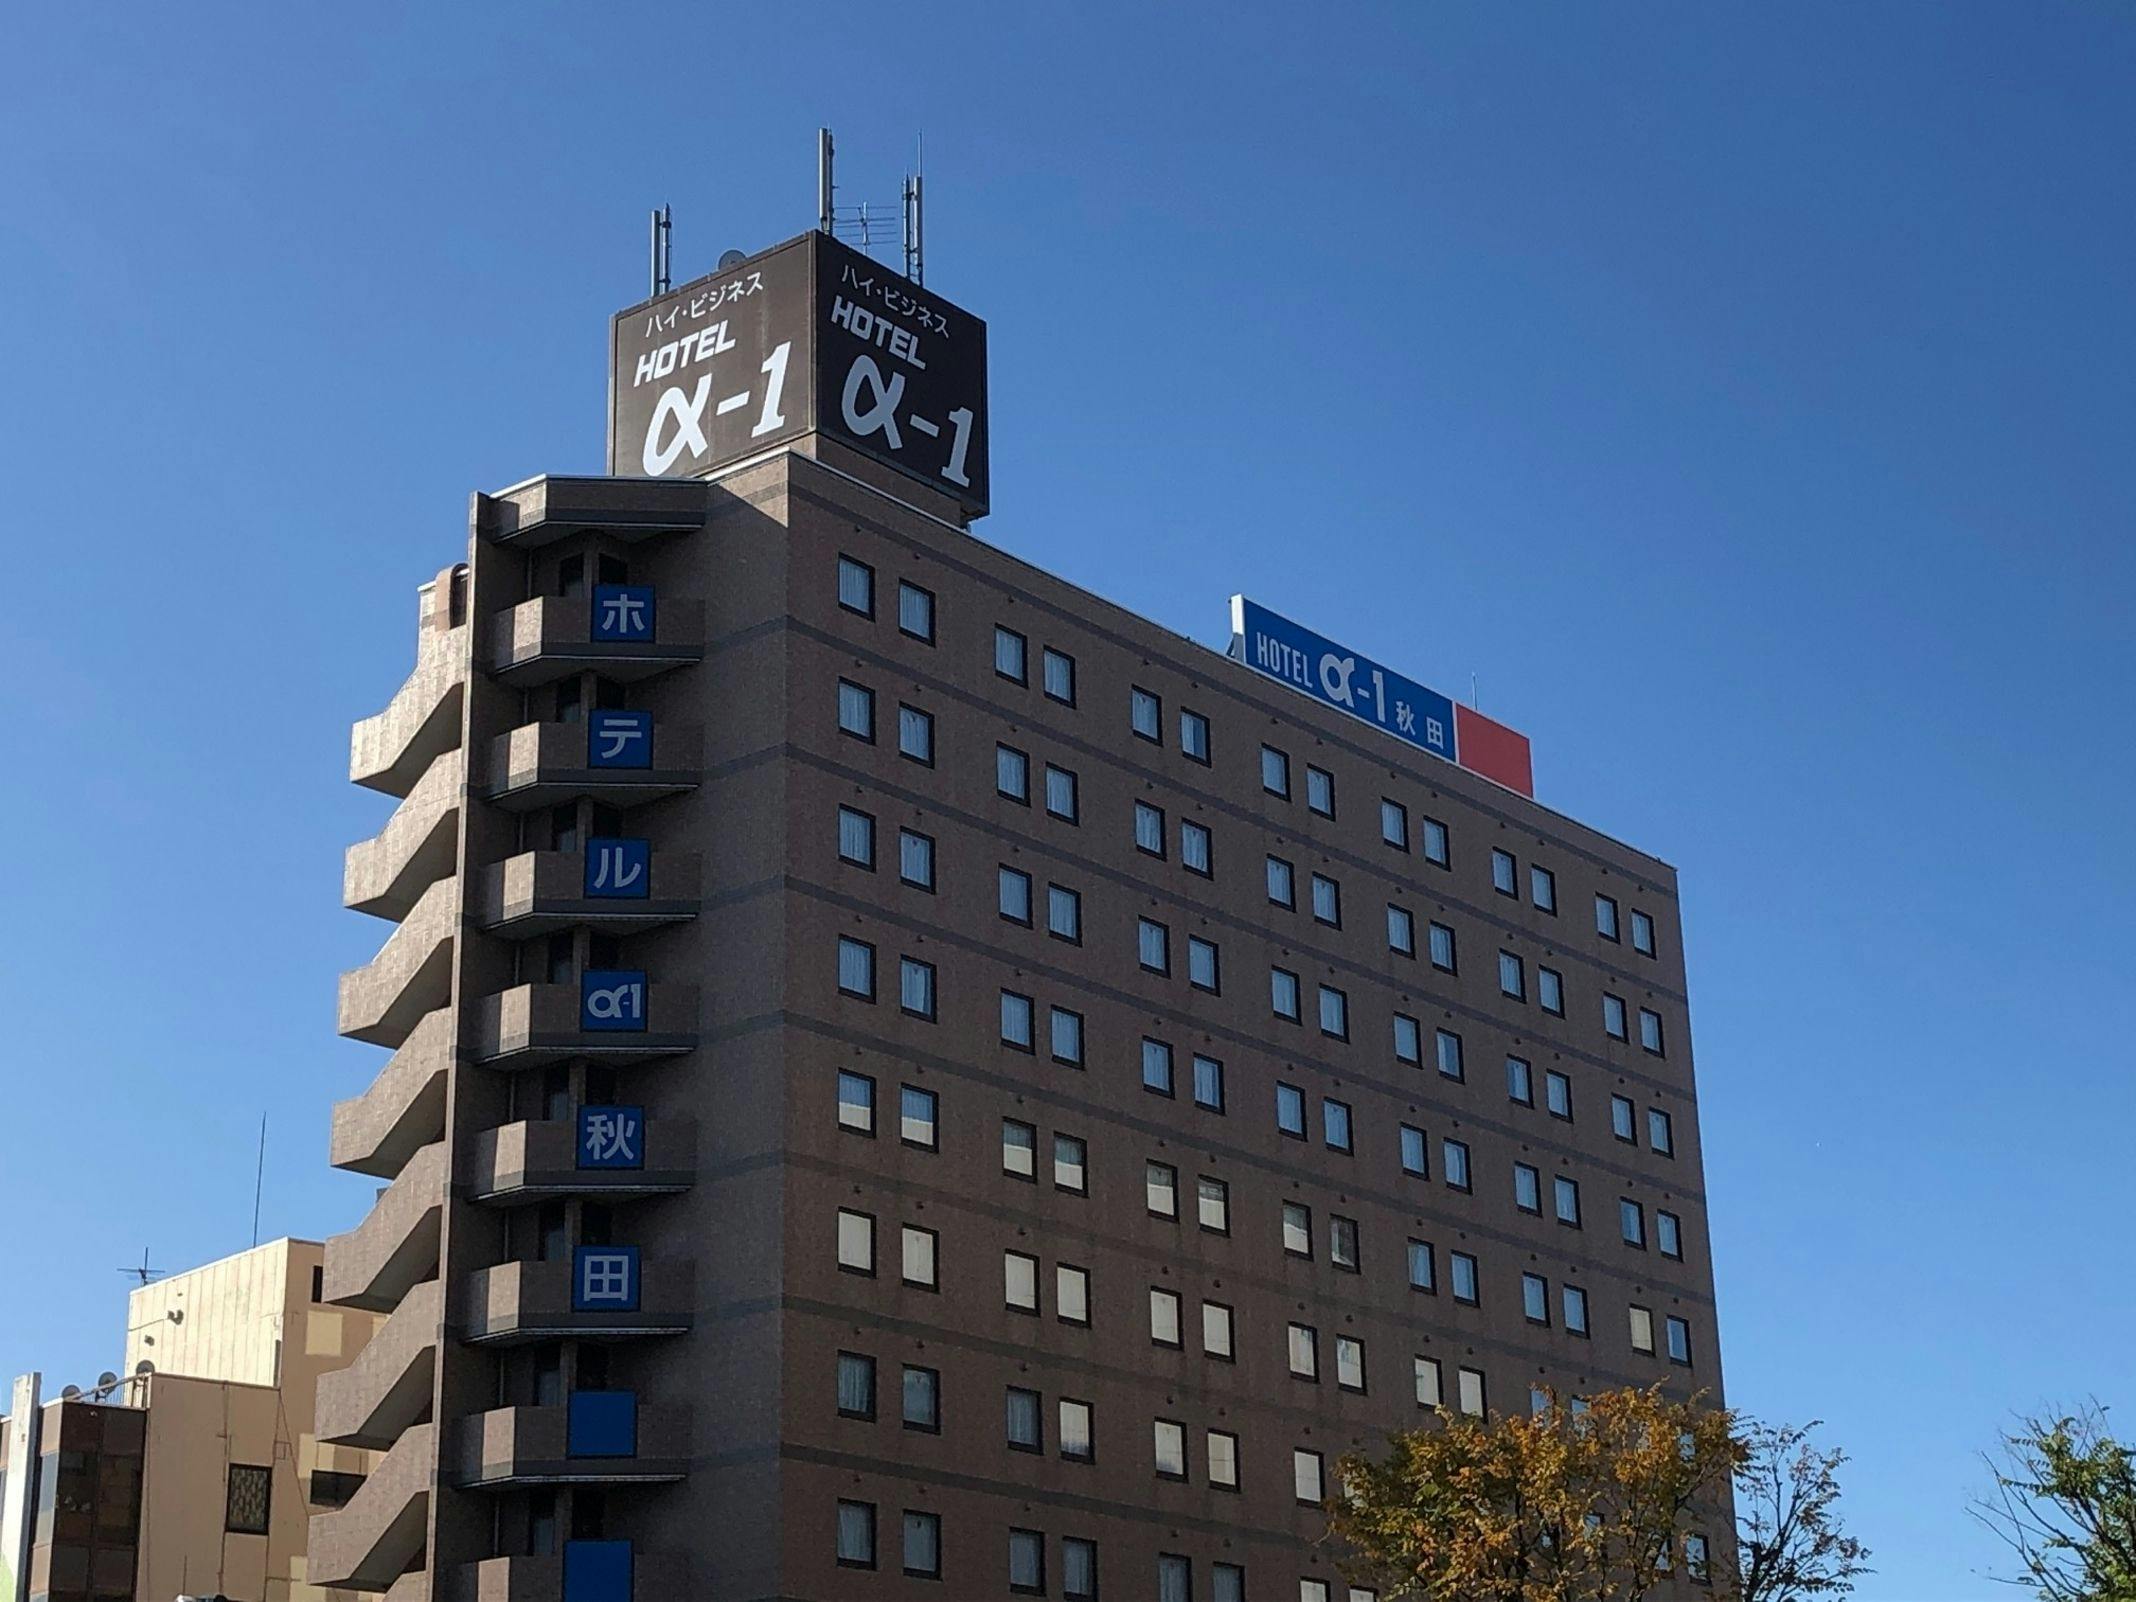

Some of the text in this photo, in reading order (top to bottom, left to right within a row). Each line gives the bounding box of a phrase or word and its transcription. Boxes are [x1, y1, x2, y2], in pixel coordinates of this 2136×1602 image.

[645, 271, 764, 338] ハイ・ビジネス
[831, 295, 928, 370] HOTEL
[842, 264, 950, 338] ハイ・ビジネス
[633, 319, 736, 388] HOTEL
[1256, 631, 1314, 689] HOTEL
